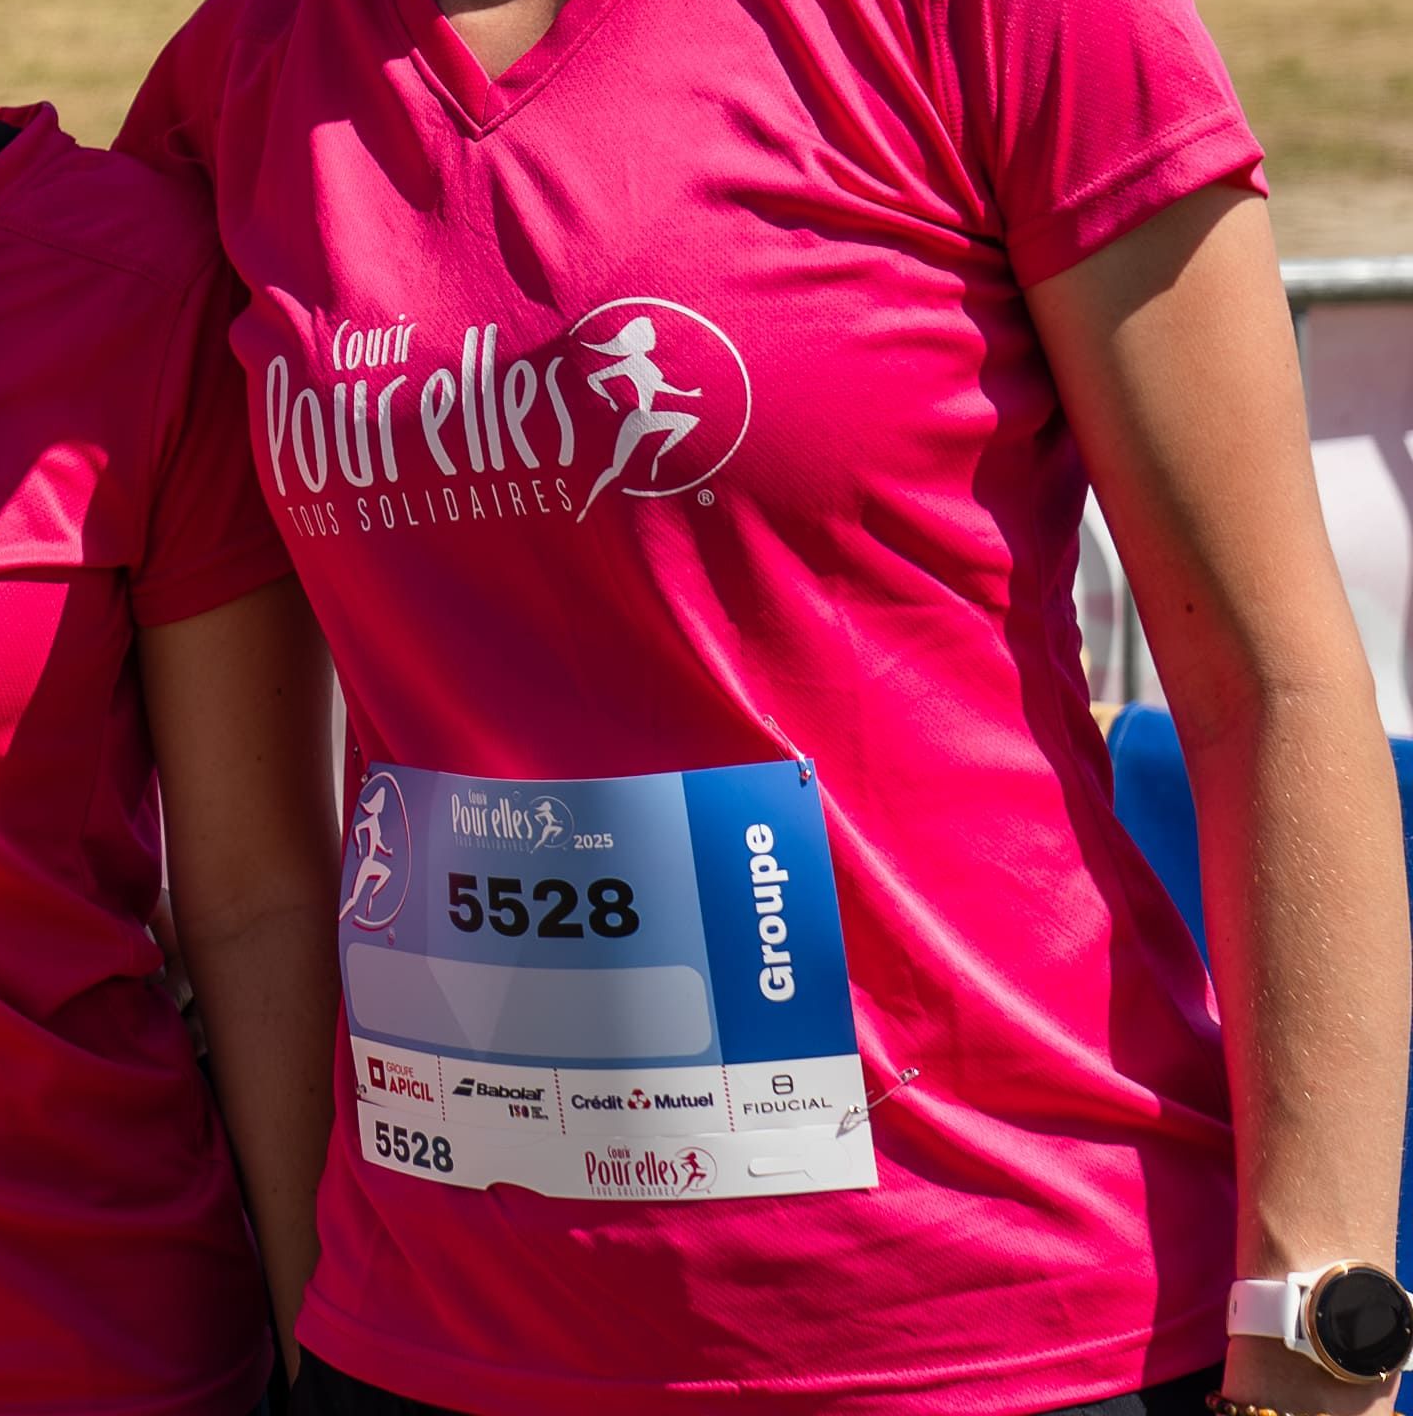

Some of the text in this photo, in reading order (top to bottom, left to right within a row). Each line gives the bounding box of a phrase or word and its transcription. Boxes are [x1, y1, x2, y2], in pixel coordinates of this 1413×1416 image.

[333, 314, 417, 371] Courir
[266, 323, 575, 497] Pour elles
[287, 478, 574, 537] TOUS SOLIDAIRES
[452, 793, 533, 840] Pour elles
[573, 833, 614, 849] 2025
[447, 872, 640, 939] 5528
[745, 823, 796, 1003] Groupe
[386, 1061, 414, 1078] GROUPE
[389, 1077, 434, 1102] APICIL
[571, 1091, 714, 1112] Crédit Mutuel
[743, 1097, 833, 1115] FIDUCIAL
[375, 1119, 454, 1173] 5528
[585, 1151, 678, 1186] Pour elles
